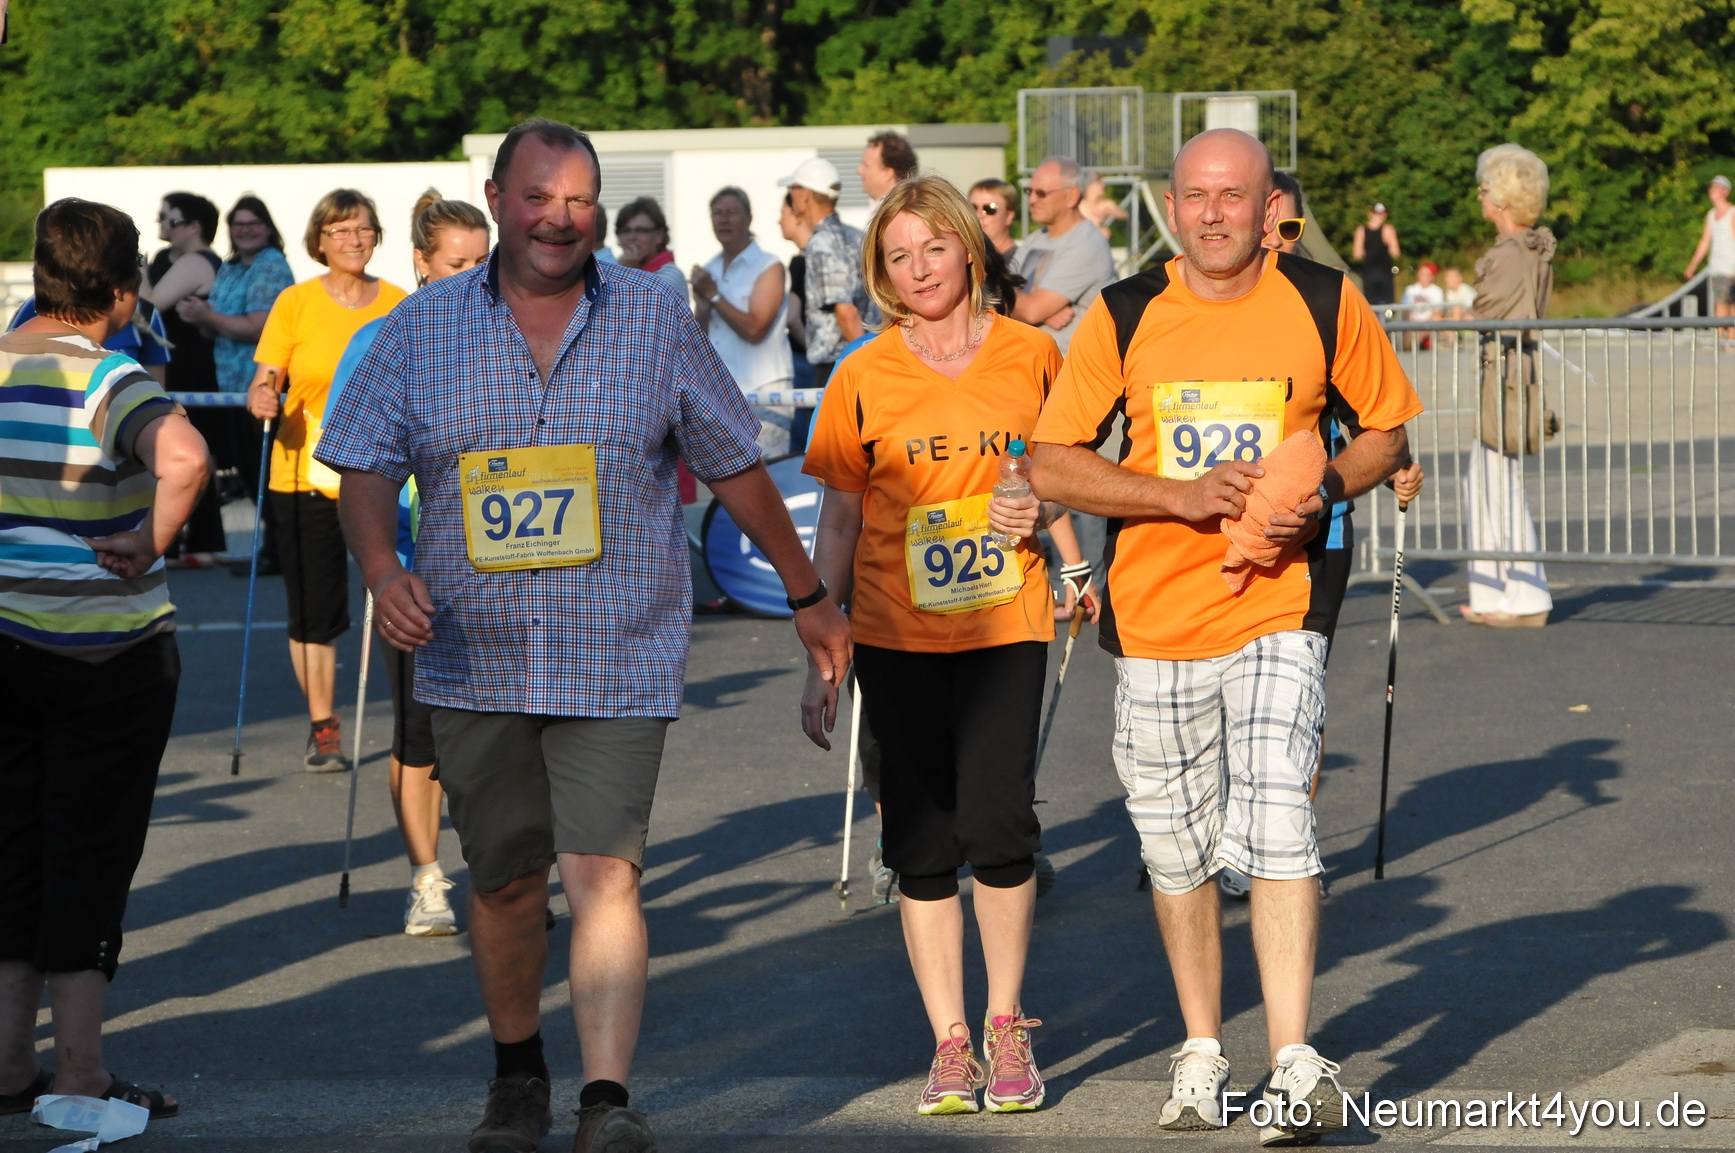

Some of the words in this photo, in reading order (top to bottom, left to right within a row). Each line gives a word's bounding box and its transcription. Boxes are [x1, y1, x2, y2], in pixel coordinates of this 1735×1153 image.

[1173, 401, 1219, 410] firmenlauf
[1161, 414, 1196, 423] walken
[1173, 424, 1262, 468] 928
[480, 468, 526, 481] firmenlauf
[469, 484, 505, 495] walken
[481, 488, 574, 541] 927
[921, 519, 962, 532] firmenlauf
[506, 541, 524, 550] Franz
[526, 540, 560, 548] Eichinger
[910, 535, 945, 546] walken
[475, 552, 535, 562] PE-Kunststoff-Fabrik
[924, 535, 1005, 587] 925
[951, 584, 979, 594] Michaela
[918, 594, 977, 608] PE-Kunststoff-Fabrik
[978, 589, 1005, 599] Woffenbach
